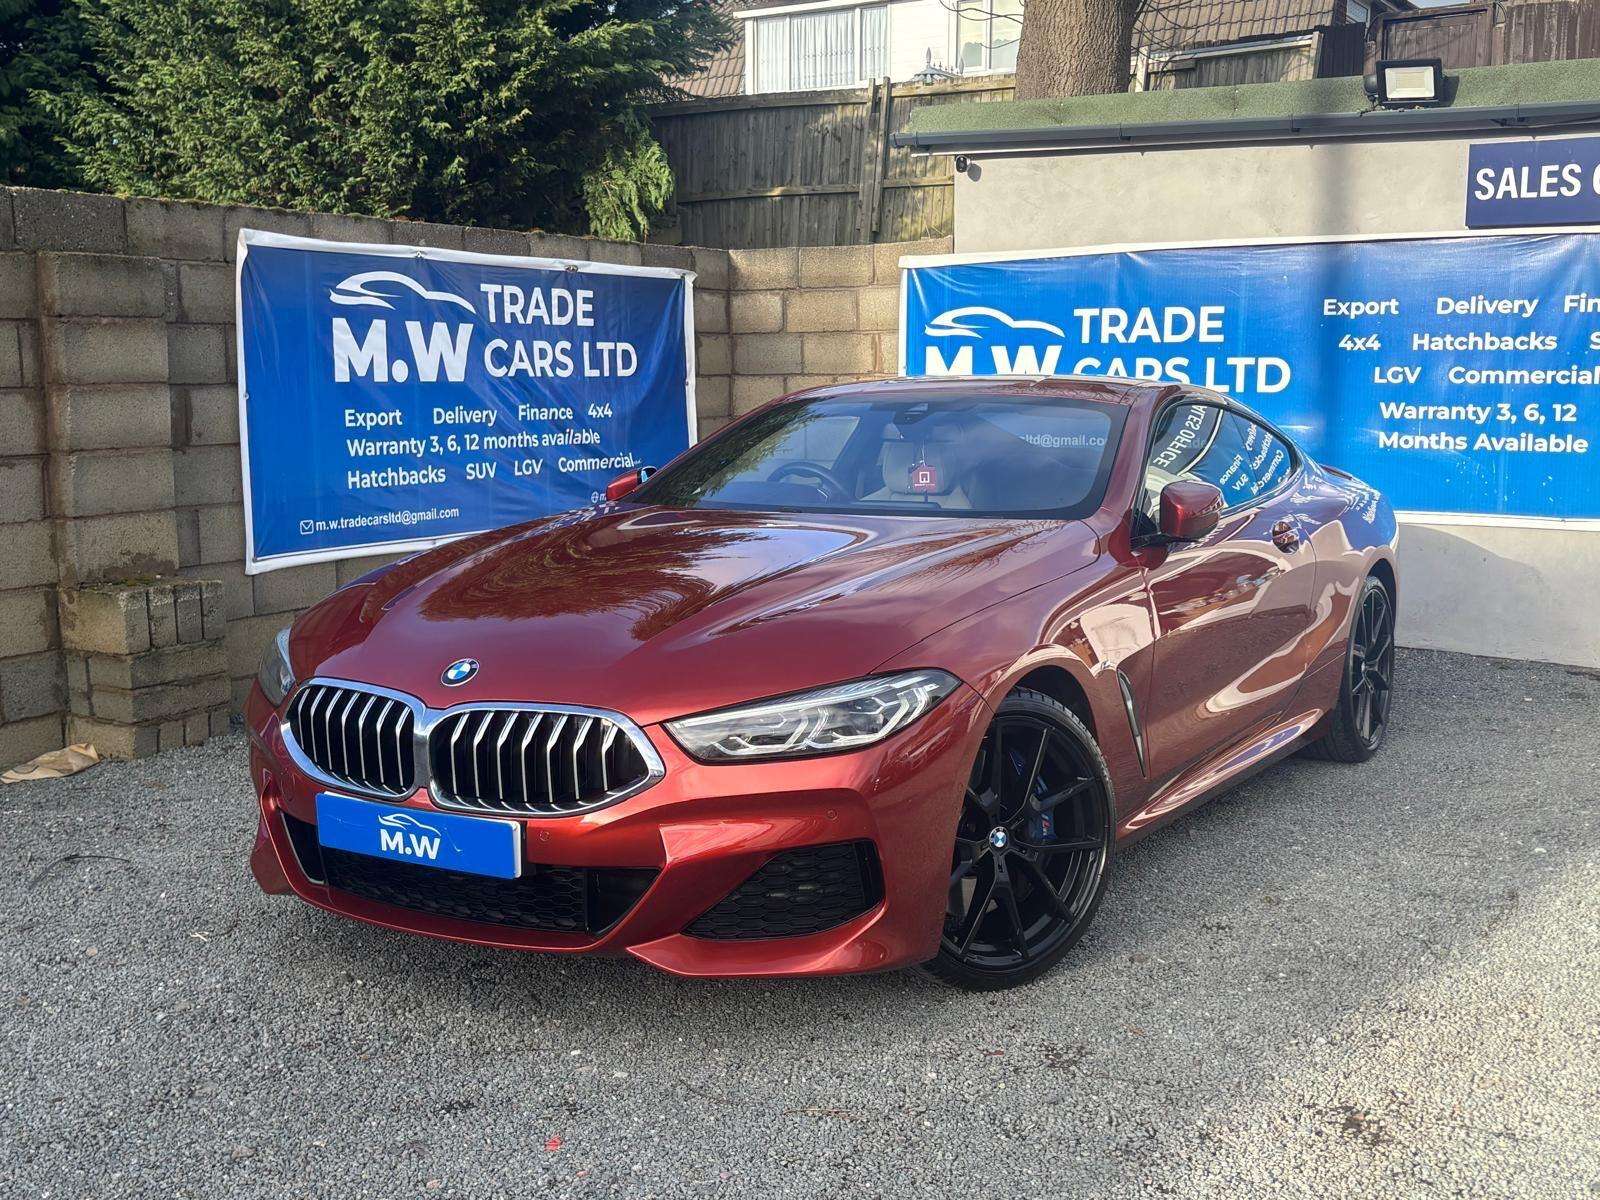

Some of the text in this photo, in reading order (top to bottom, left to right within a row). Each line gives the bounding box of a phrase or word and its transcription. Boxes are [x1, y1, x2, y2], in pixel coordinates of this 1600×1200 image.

[1474, 163, 1582, 201] SALES
[480, 283, 595, 327] TRADE
[1323, 297, 1399, 319] Export
[1436, 294, 1539, 318] Delivery
[1073, 305, 1226, 344] TRADE
[332, 318, 474, 383] M.W
[1338, 333, 1381, 351] 4x4
[1412, 331, 1558, 351] Hatchbacks
[484, 340, 638, 378] CARS LTD
[925, 345, 1063, 376] MW
[1374, 364, 1600, 385] LGV Commercial
[1205, 357, 1291, 393] LTD
[345, 402, 613, 430] Export Delivery Finance 4x4
[1380, 402, 1577, 424] Warranty 3, 6, 12
[346, 429, 601, 459] Warranty 3, 6, 12 months available
[1379, 432, 1589, 453] Months Available
[347, 452, 634, 490] Hatchbacks SUV LGV Commercial
[315, 506, 460, 533] m.w.tradecarsltd@gmail.com
[379, 828, 441, 860] M.W
